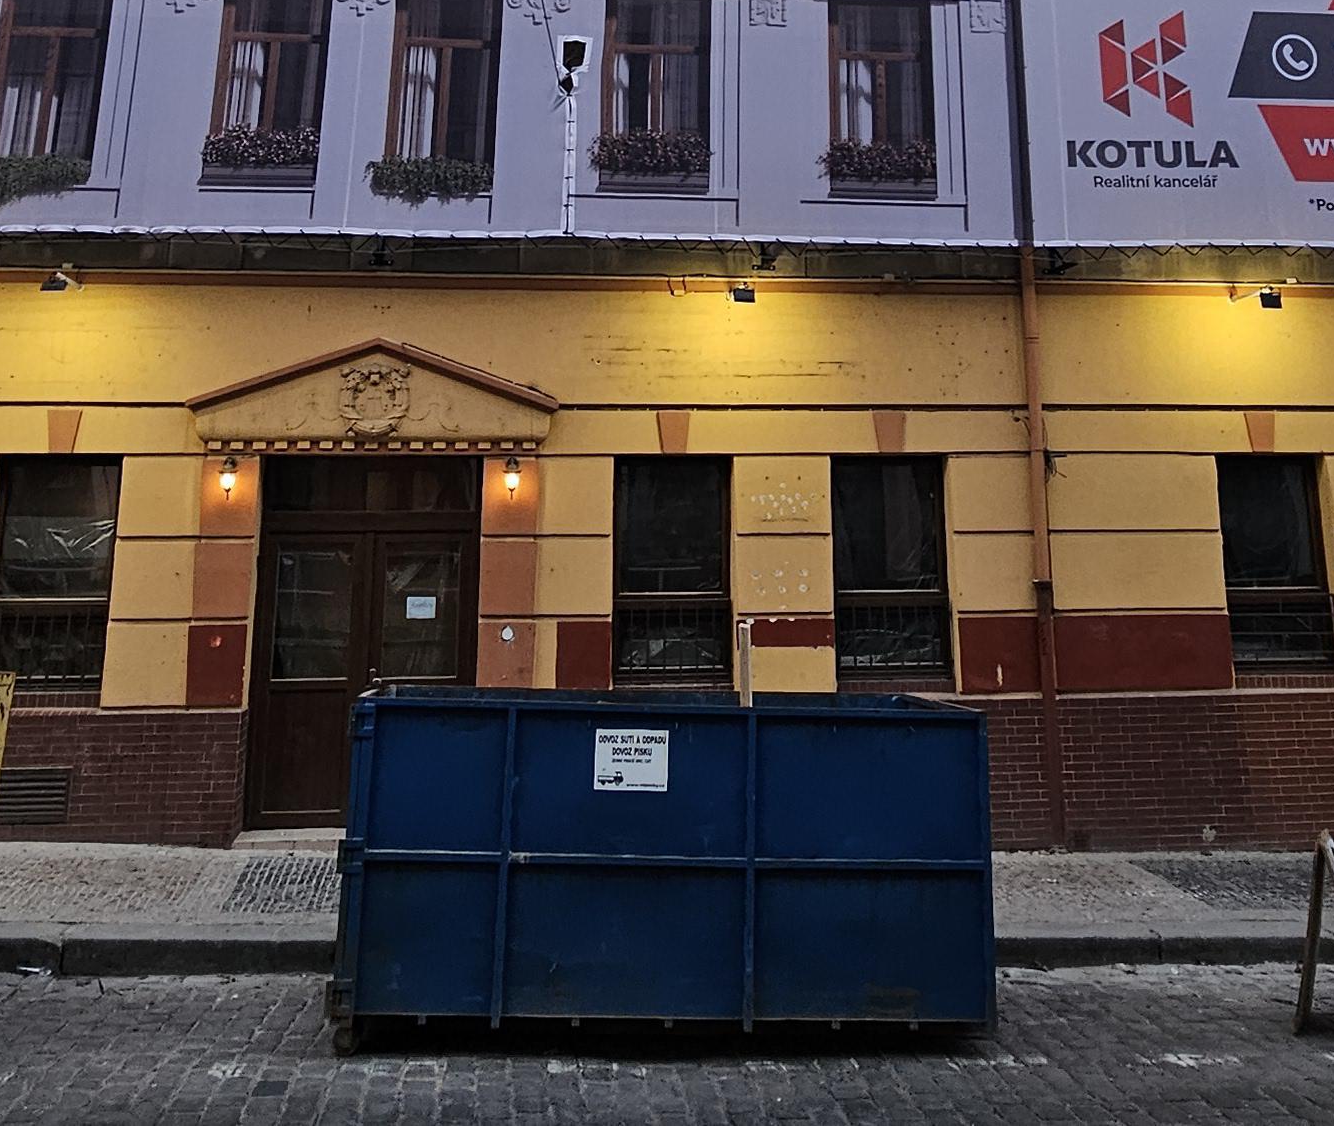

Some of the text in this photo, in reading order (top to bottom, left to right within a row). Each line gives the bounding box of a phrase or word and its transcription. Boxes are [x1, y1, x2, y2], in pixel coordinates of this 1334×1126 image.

[1066, 139, 1240, 169] KOTULA
[1093, 173, 1219, 189] Realitní kancelář
[612, 746, 633, 756] DOVOZ
